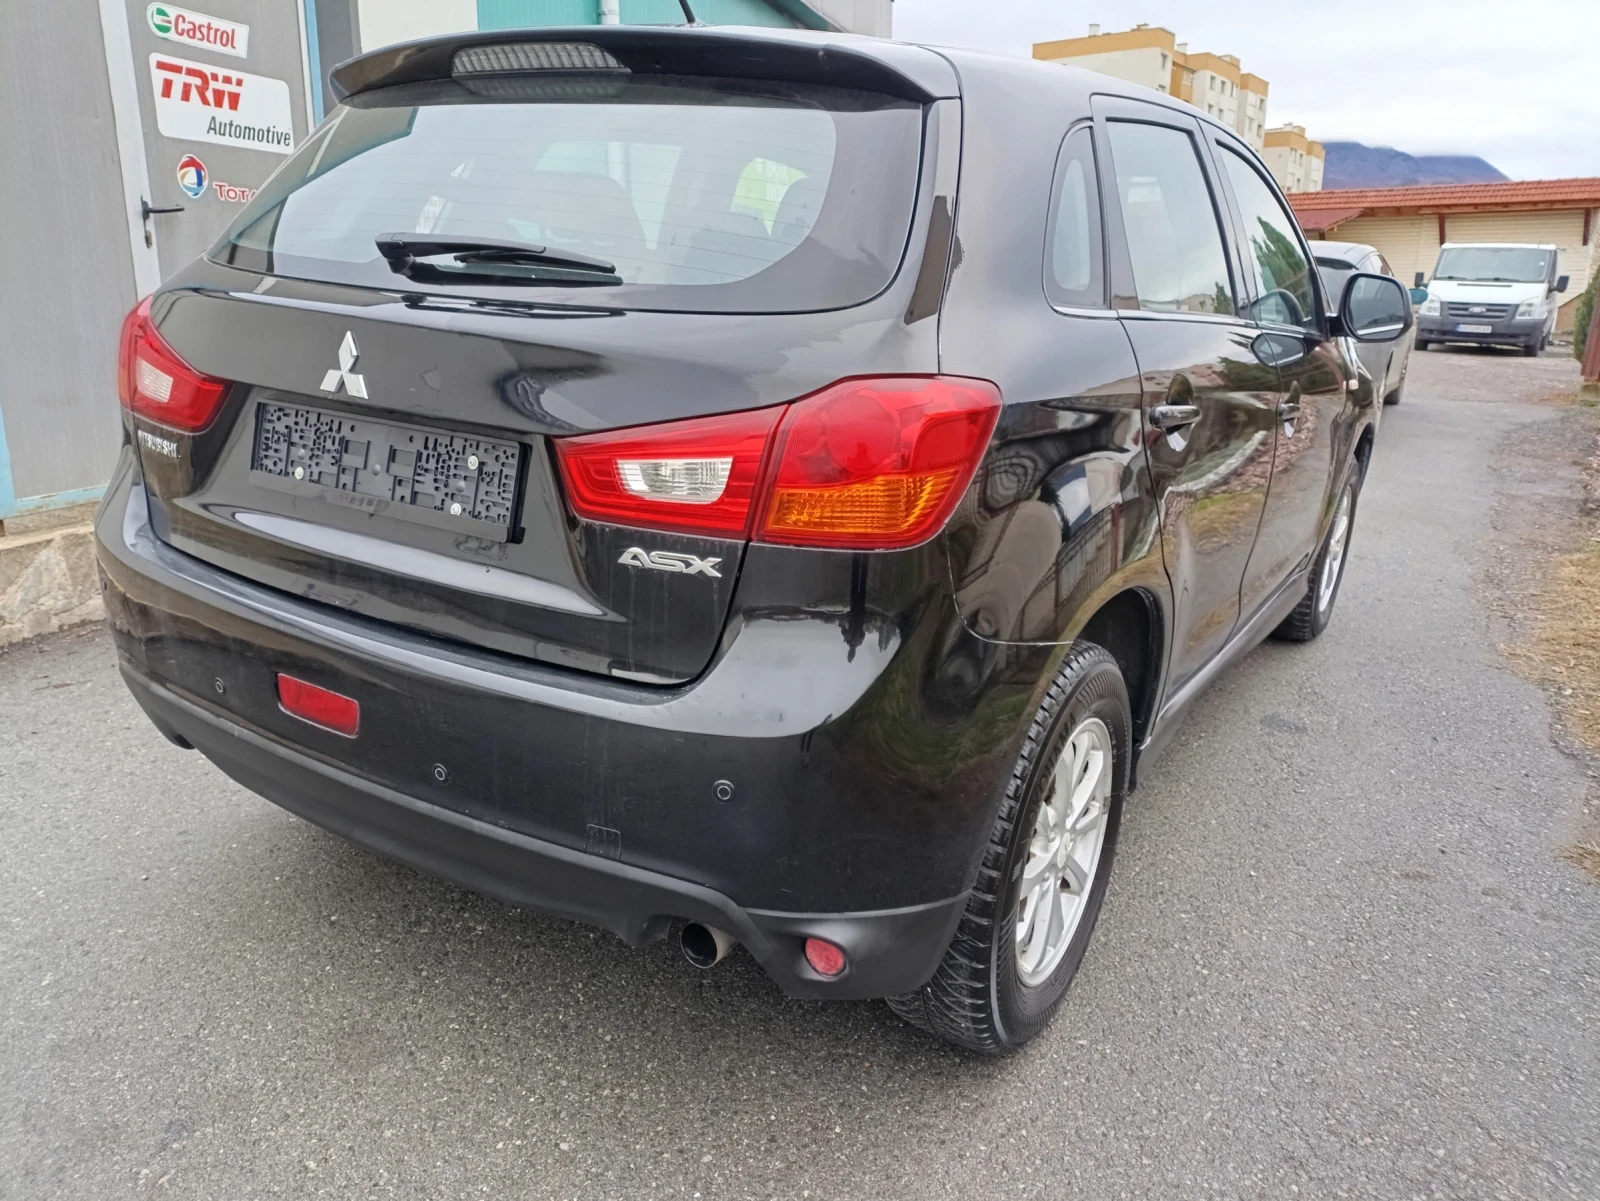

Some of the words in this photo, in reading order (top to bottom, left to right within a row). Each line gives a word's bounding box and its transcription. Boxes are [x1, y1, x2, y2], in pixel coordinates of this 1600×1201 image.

[174, 13, 237, 50] Castrol
[155, 60, 244, 112] TRW
[206, 115, 292, 147] Automotive
[617, 546, 723, 578] ASX
